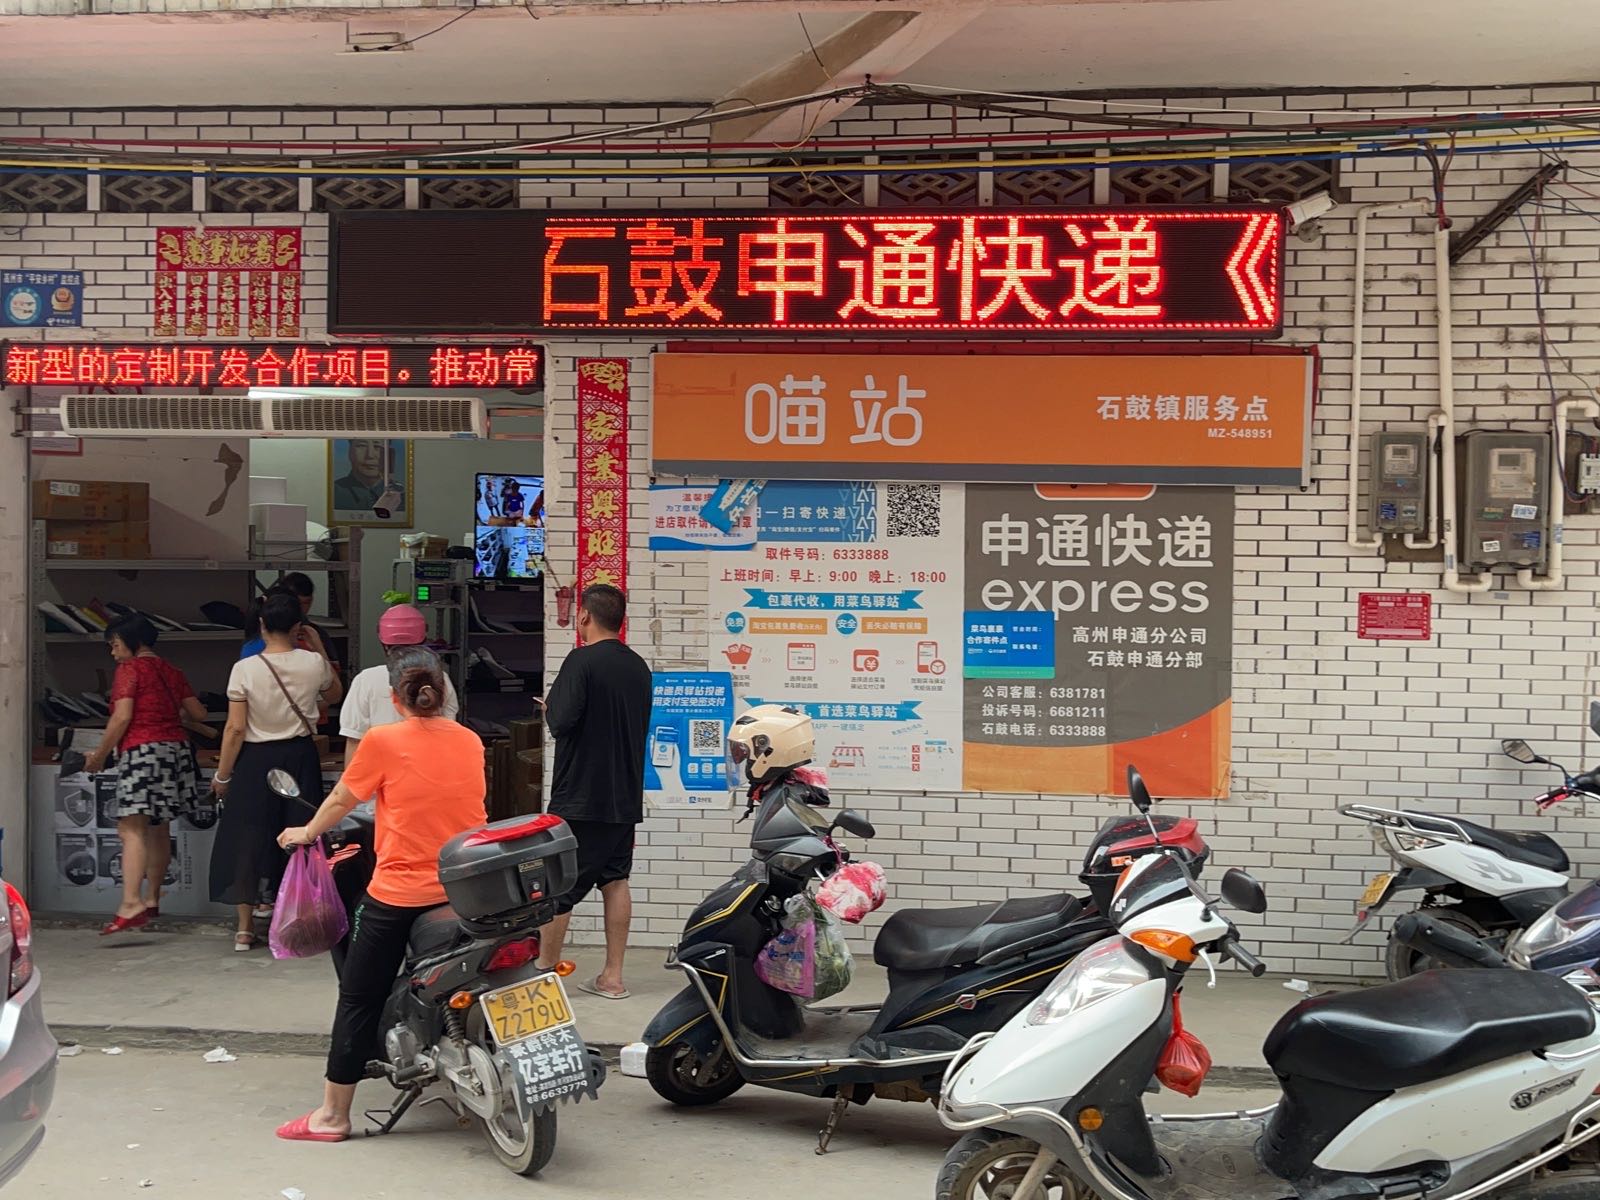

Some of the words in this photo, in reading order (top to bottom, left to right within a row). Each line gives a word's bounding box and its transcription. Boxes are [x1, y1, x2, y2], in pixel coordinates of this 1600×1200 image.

[542, 217, 1163, 322] 石鼓申通快递
[744, 373, 927, 448] 喵站
[1096, 395, 1270, 422] 石鼓镇服务点
[1207, 427, 1273, 439] MZ-548951
[981, 513, 1214, 568] 申通快递
[767, 593, 900, 608] 包裹代收，用菜鸟驿站
[981, 578, 1210, 621] express
[836, 617, 858, 629] 安全
[966, 636, 1008, 645] 合作寄件点
[1072, 627, 1208, 645] 高州申通分公司
[1087, 651, 1204, 669] 石鼓申通分部
[982, 685, 1106, 700] 公司客服：6381781
[982, 704, 1106, 719] 投诉号码：6681211
[982, 722, 1107, 738] 石鼓电话：6333888
[496, 998, 565, 1039] Z279U
[517, 1043, 583, 1085] 亿宝车行
